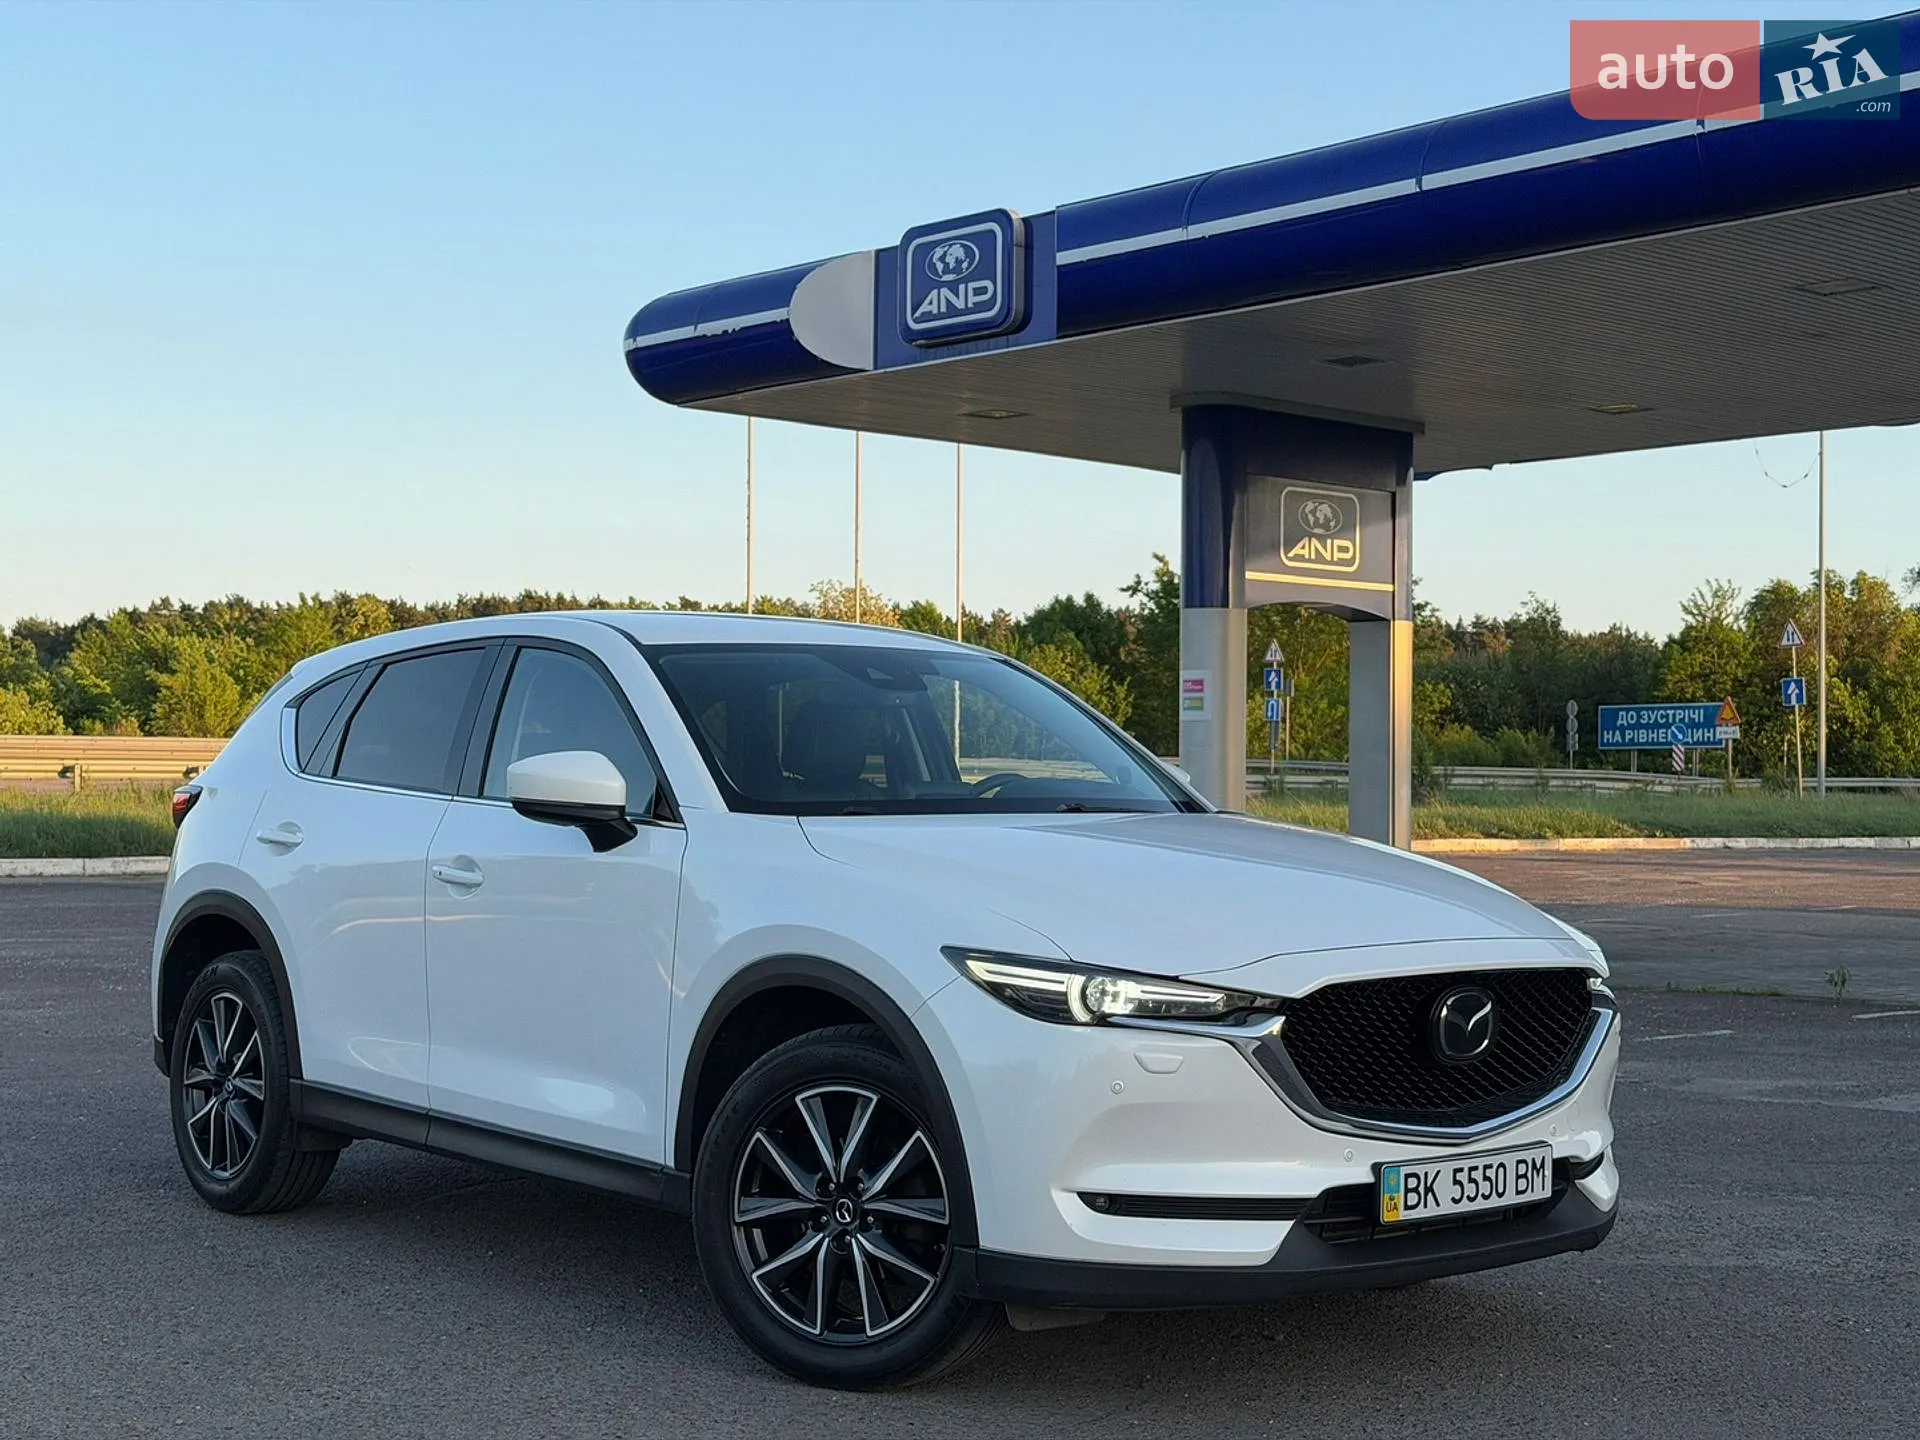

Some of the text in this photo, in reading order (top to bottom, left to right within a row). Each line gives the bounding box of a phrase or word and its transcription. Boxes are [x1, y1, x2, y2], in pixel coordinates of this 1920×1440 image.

[912, 280, 994, 319] ANP
[1287, 537, 1354, 561] ANP
[1617, 709, 1704, 727] ДО ЗУСТРІЧІ
[1603, 730, 1622, 743] НА
[1386, 1156, 1547, 1213] UA BK 5550 BM
